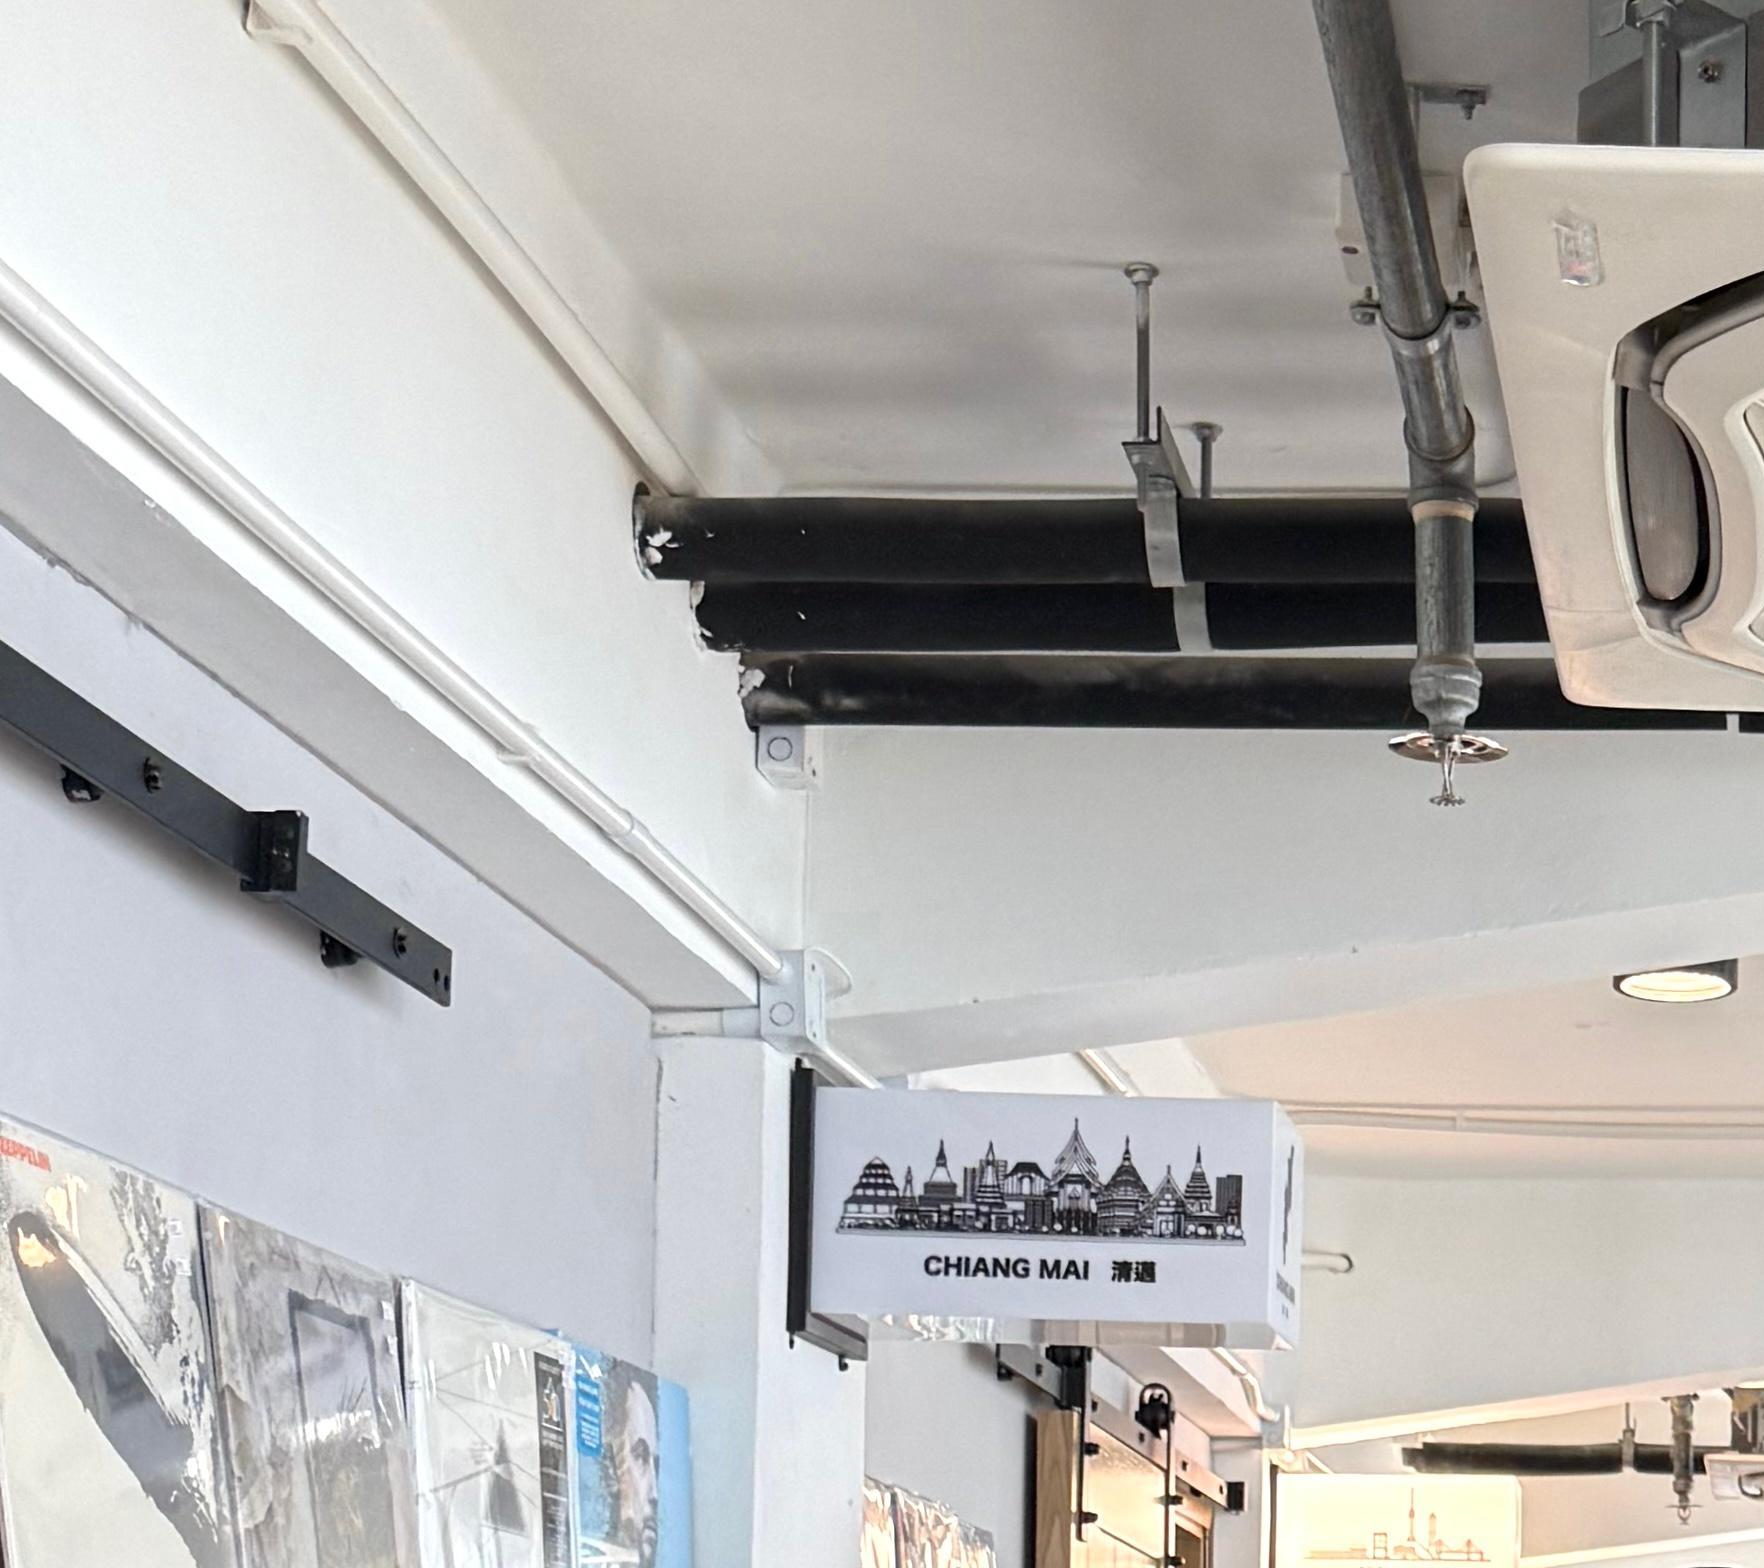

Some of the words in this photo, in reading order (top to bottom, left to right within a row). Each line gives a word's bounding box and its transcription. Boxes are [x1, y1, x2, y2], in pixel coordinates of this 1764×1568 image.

[923, 1254, 1031, 1279] CHIANG
[1039, 1259, 1090, 1281] MAI
[1111, 1260, 1157, 1283] 清邁
